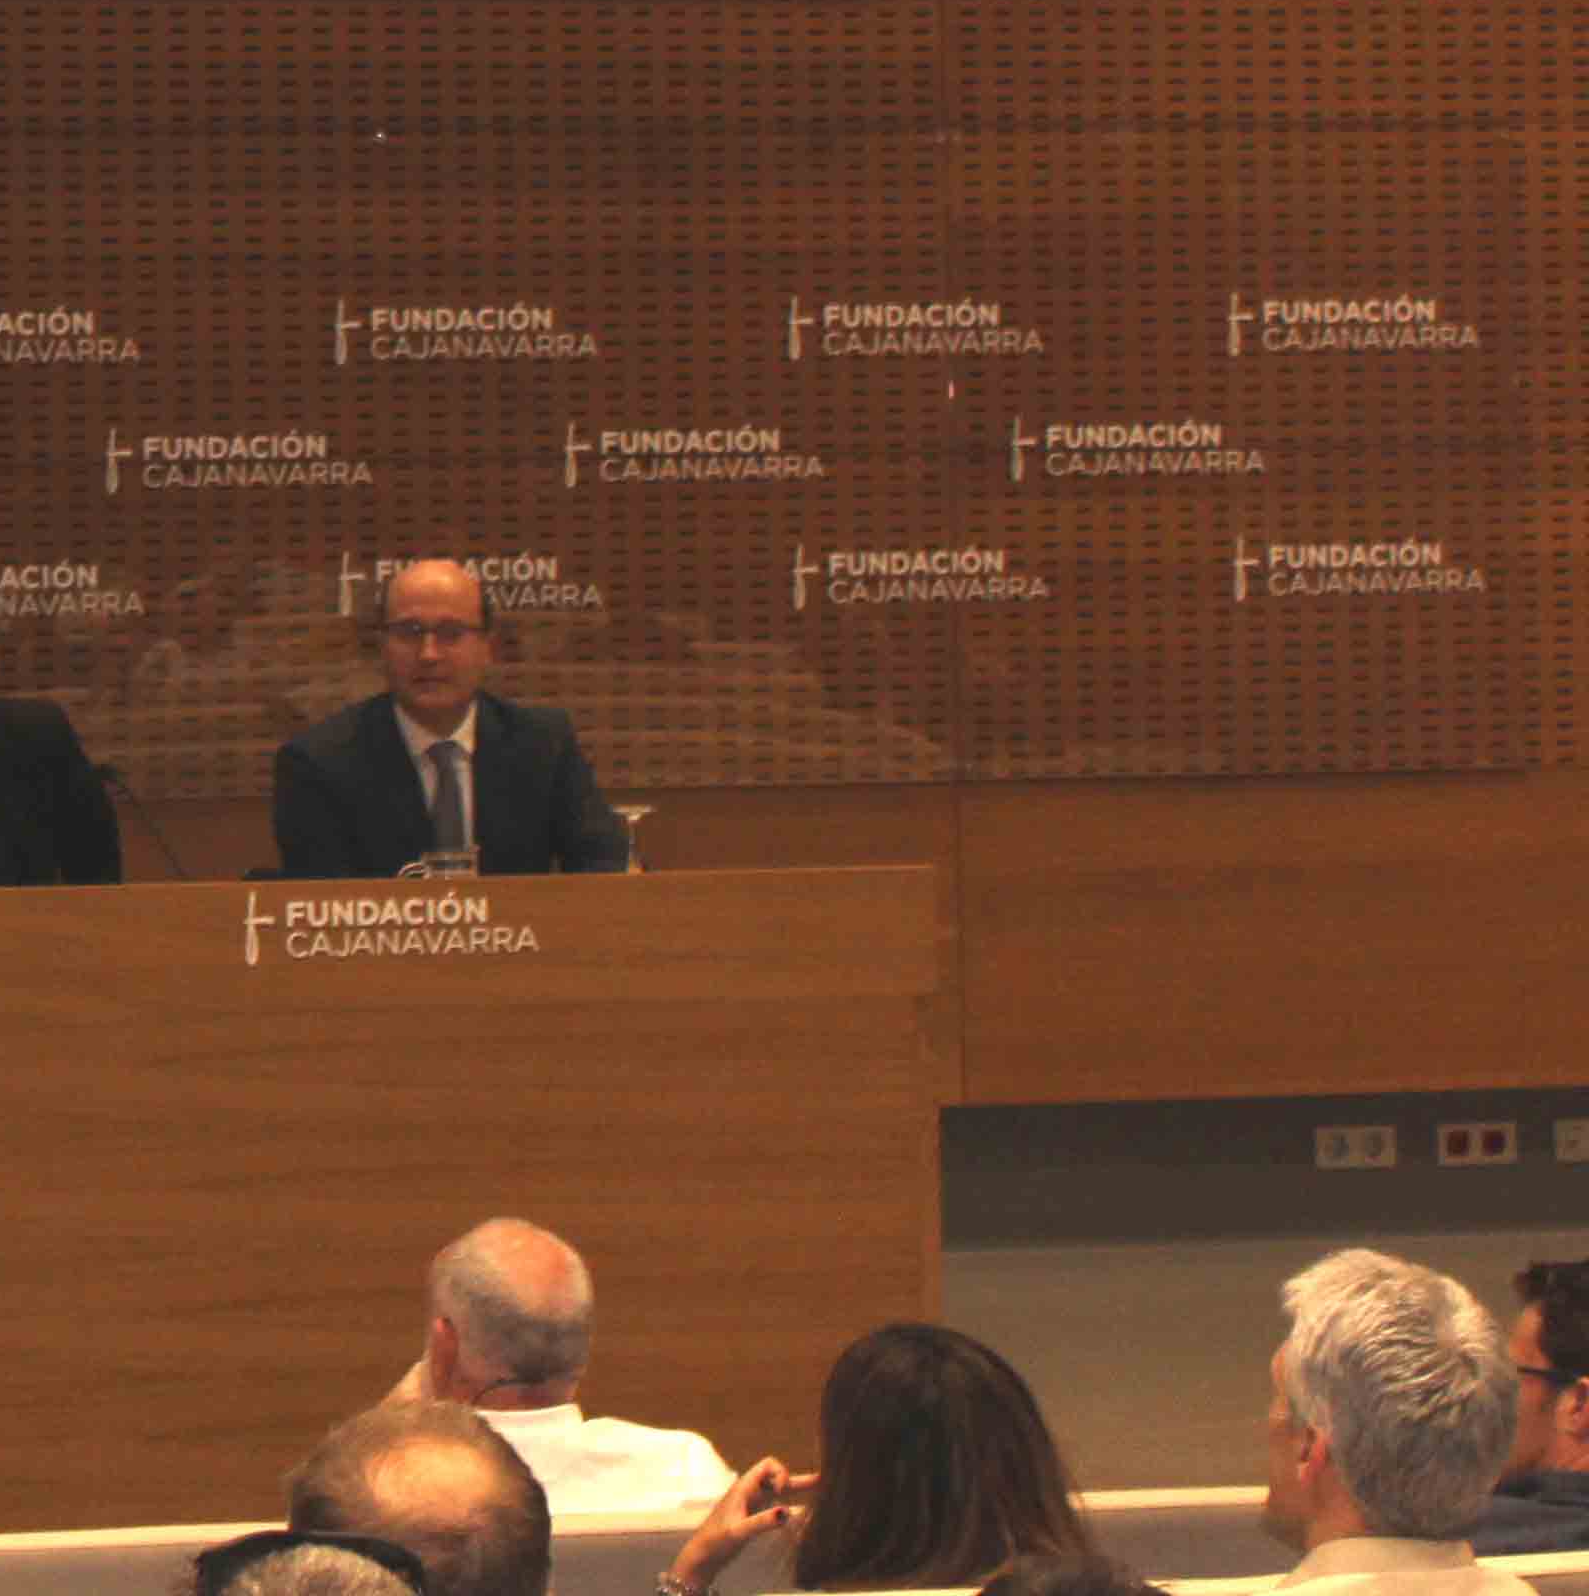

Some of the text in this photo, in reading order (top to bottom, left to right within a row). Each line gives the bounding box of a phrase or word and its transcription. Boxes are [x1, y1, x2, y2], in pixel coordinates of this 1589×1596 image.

[371, 304, 552, 333] FUNDACIÓN
[824, 300, 999, 329] FUNDACIÓN
[1264, 297, 1436, 324] FUNDACIÓN
[371, 333, 597, 360] CAJANAVARRA
[823, 329, 1043, 356] CAJANAVARRA
[1263, 325, 1478, 350] CAJANAVARRA
[142, 431, 325, 460] FUNDACIÓN
[601, 425, 779, 453] FUNDACIÓN
[1046, 422, 1221, 449] FUNDACIÓN
[142, 461, 372, 487] CAJANAVARRA
[600, 455, 823, 483] CAJANAVARRA
[1045, 451, 1265, 477] CAJANAVARRA
[829, 548, 1002, 576] FUNDACIÓN
[1269, 540, 1440, 567] FUNDACIÓN
[828, 577, 1048, 603] CAJANAVARRA
[1267, 569, 1485, 596] CAJANAVARRA
[286, 891, 487, 927] FUNDACIÓN
[286, 927, 540, 958] CAJANAVARRA
